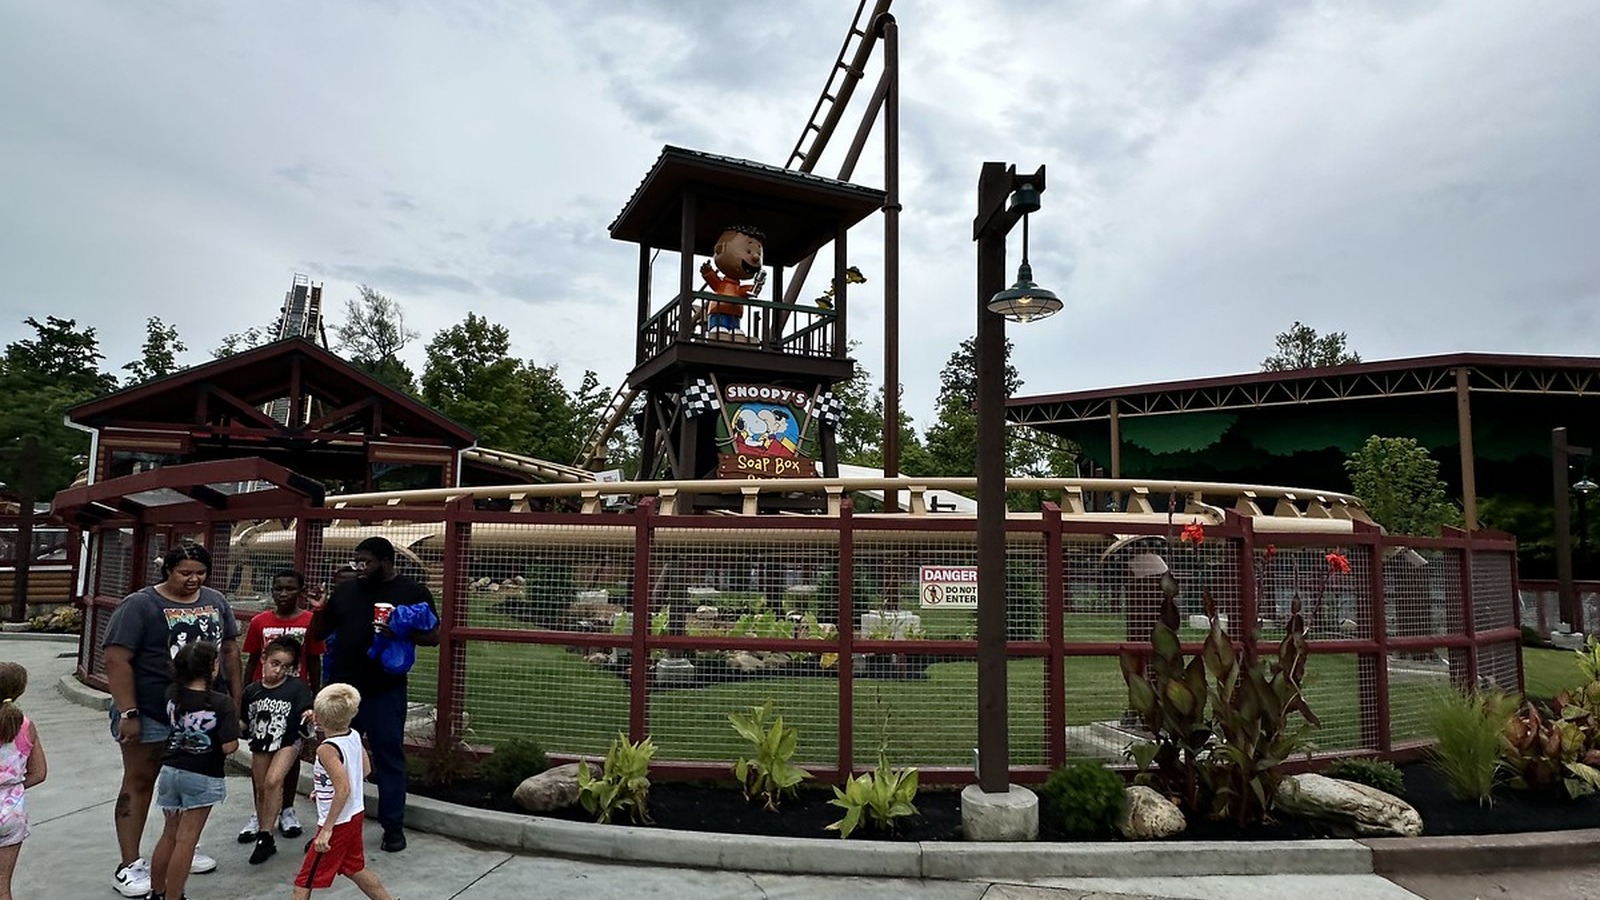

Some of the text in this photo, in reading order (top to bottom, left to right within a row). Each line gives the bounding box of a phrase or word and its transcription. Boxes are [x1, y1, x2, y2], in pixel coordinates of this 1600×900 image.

[728, 386, 805, 404] SNOOPY'S
[775, 457, 800, 475] Box
[924, 569, 978, 582] DANGER
[945, 586, 977, 594] DO NOT
[945, 595, 977, 603] ENTER
